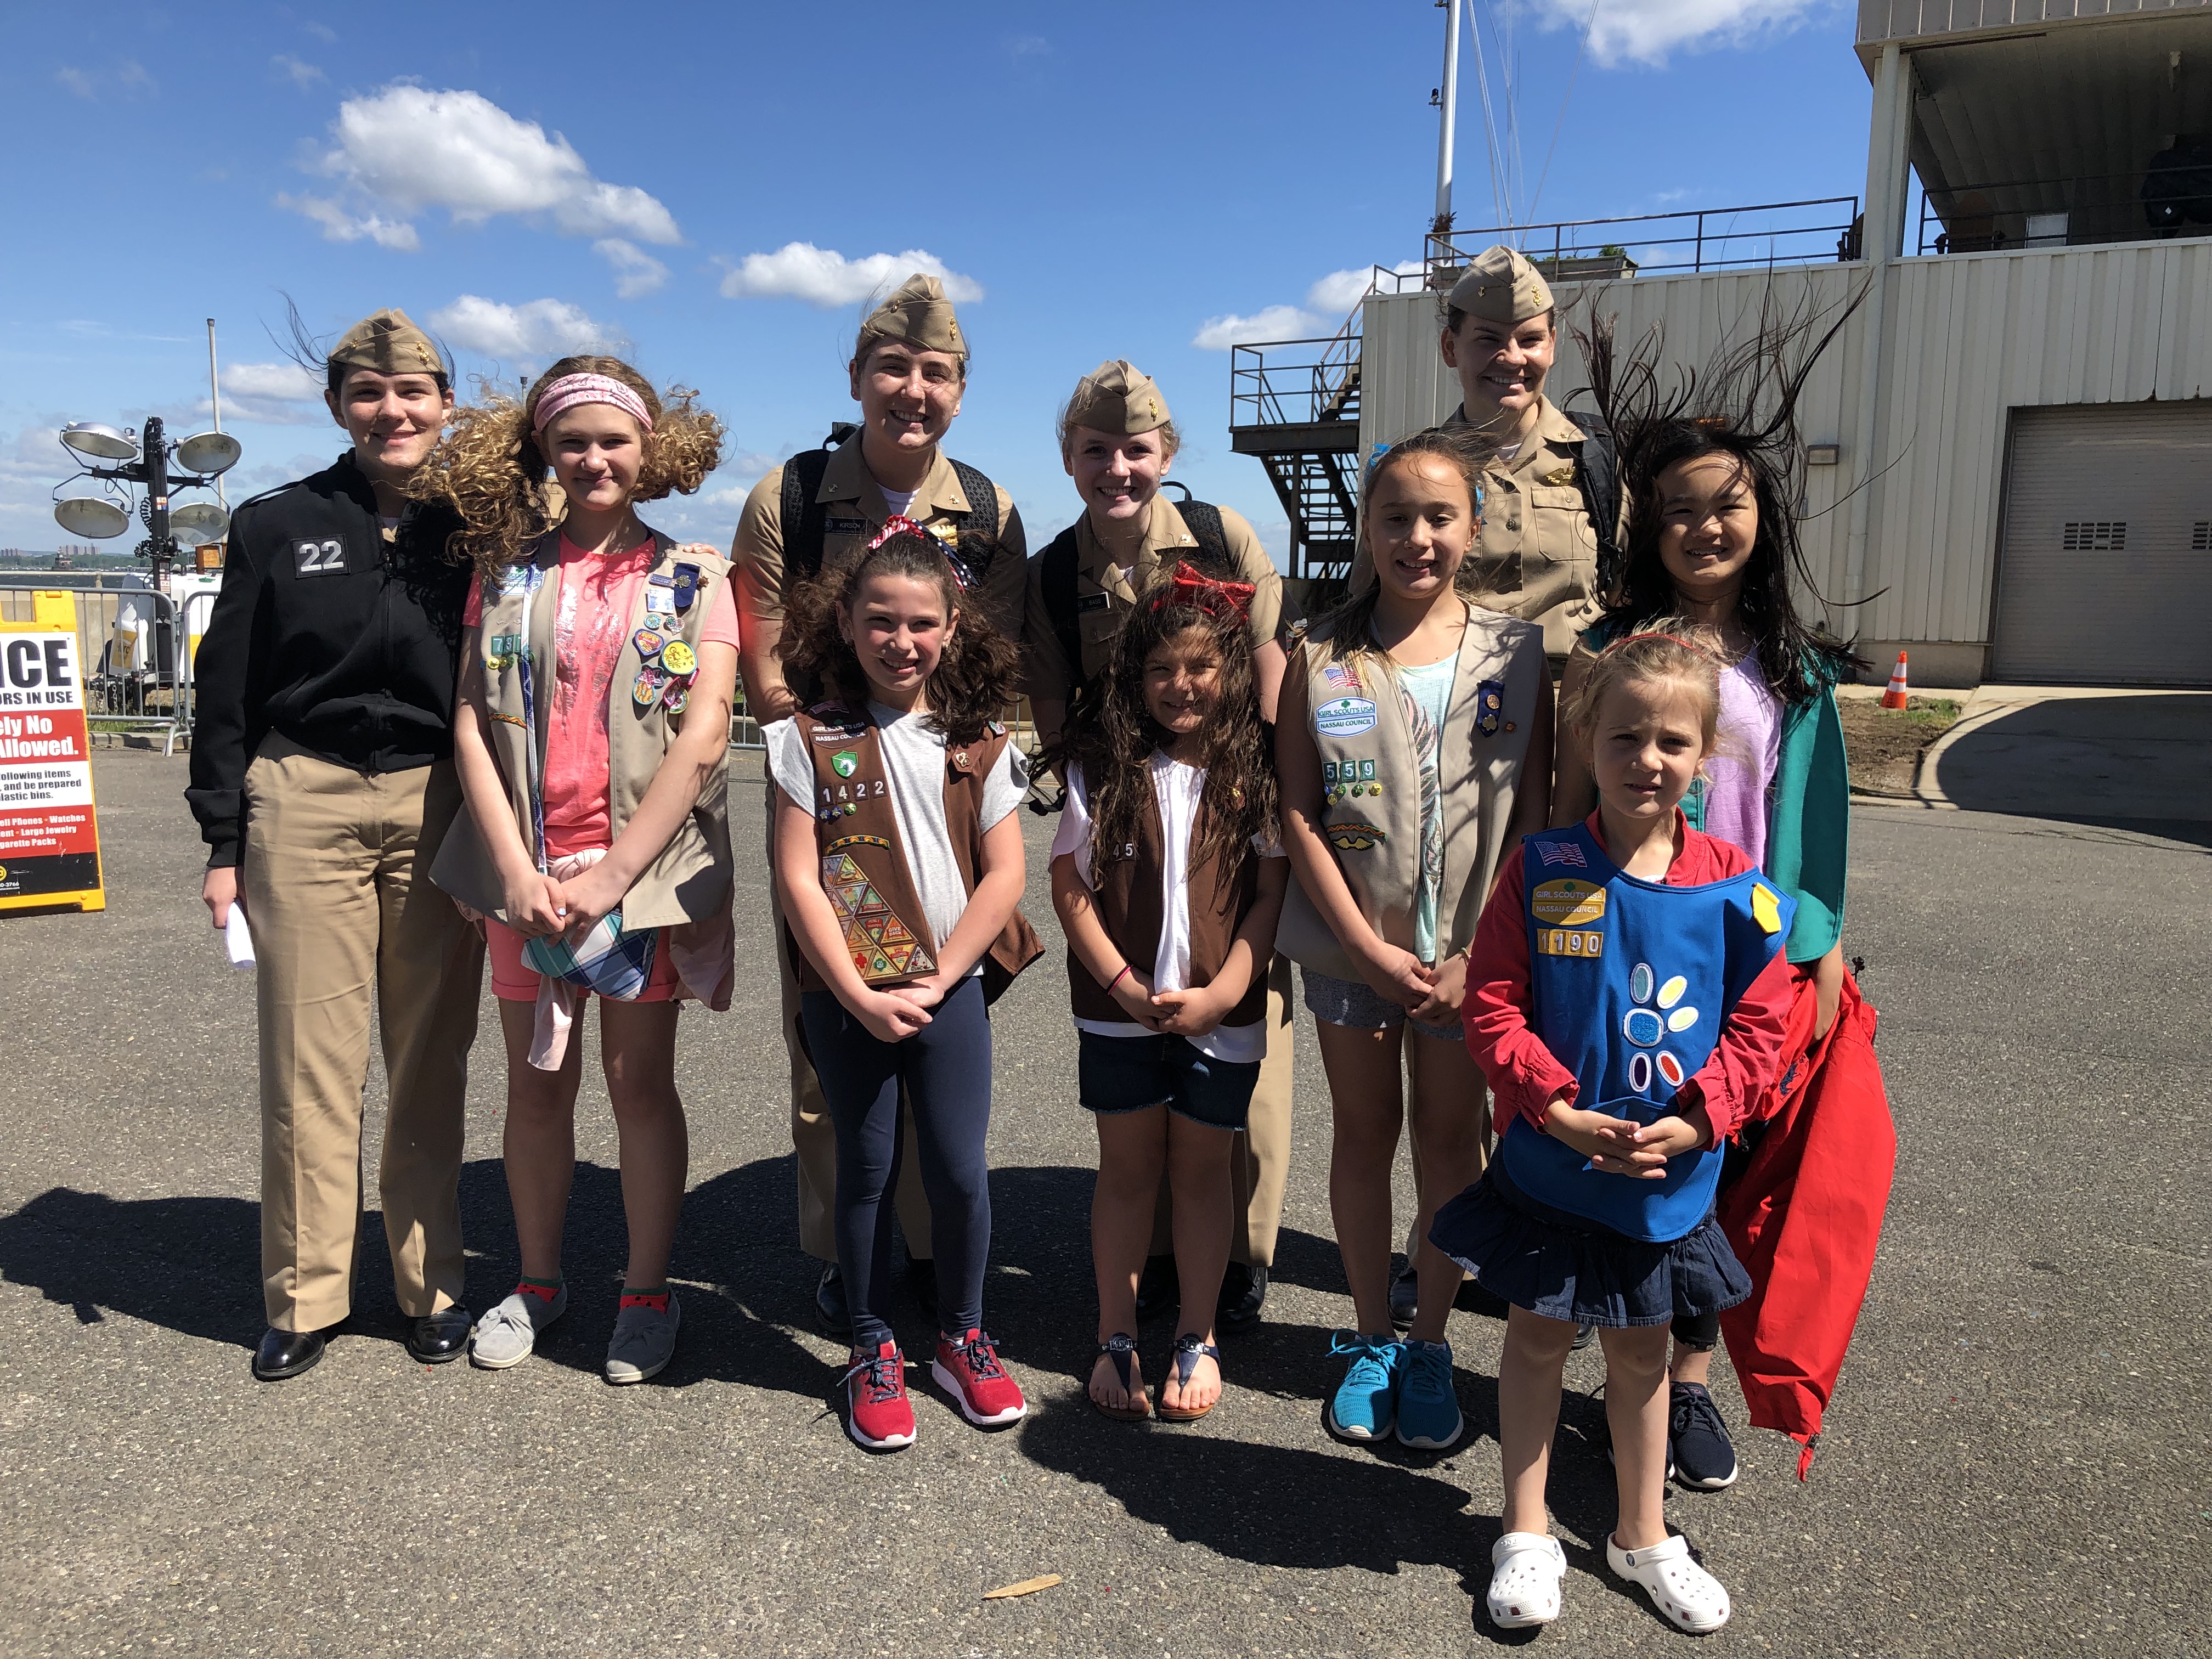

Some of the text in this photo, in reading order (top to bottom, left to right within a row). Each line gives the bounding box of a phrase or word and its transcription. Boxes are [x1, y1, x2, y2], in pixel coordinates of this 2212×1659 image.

[299, 540, 344, 572] 22
[641, 633, 659, 643] SUPER
[0, 691, 74, 705] RS IN USE
[1334, 707, 1359, 715] SCOUTS
[26, 715, 53, 735] No
[828, 723, 853, 732] SCOUTS
[853, 721, 866, 729] USA
[1320, 721, 1344, 729] NASSAU
[840, 731, 866, 740] COUNCIL
[0, 770, 71, 781] ollowing items
[1327, 762, 1373, 780] 559
[3, 778, 82, 791] and be prepared
[0, 791, 54, 802] lastic bins.
[822, 780, 885, 803] 1422
[0, 814, 86, 827] ell Phones Watches
[20, 828, 45, 836] Large
[45, 825, 77, 834] Jewelry
[31, 837, 58, 846] Packs
[1536, 890, 1553, 899] GIRL
[1541, 932, 1599, 953] 1190
